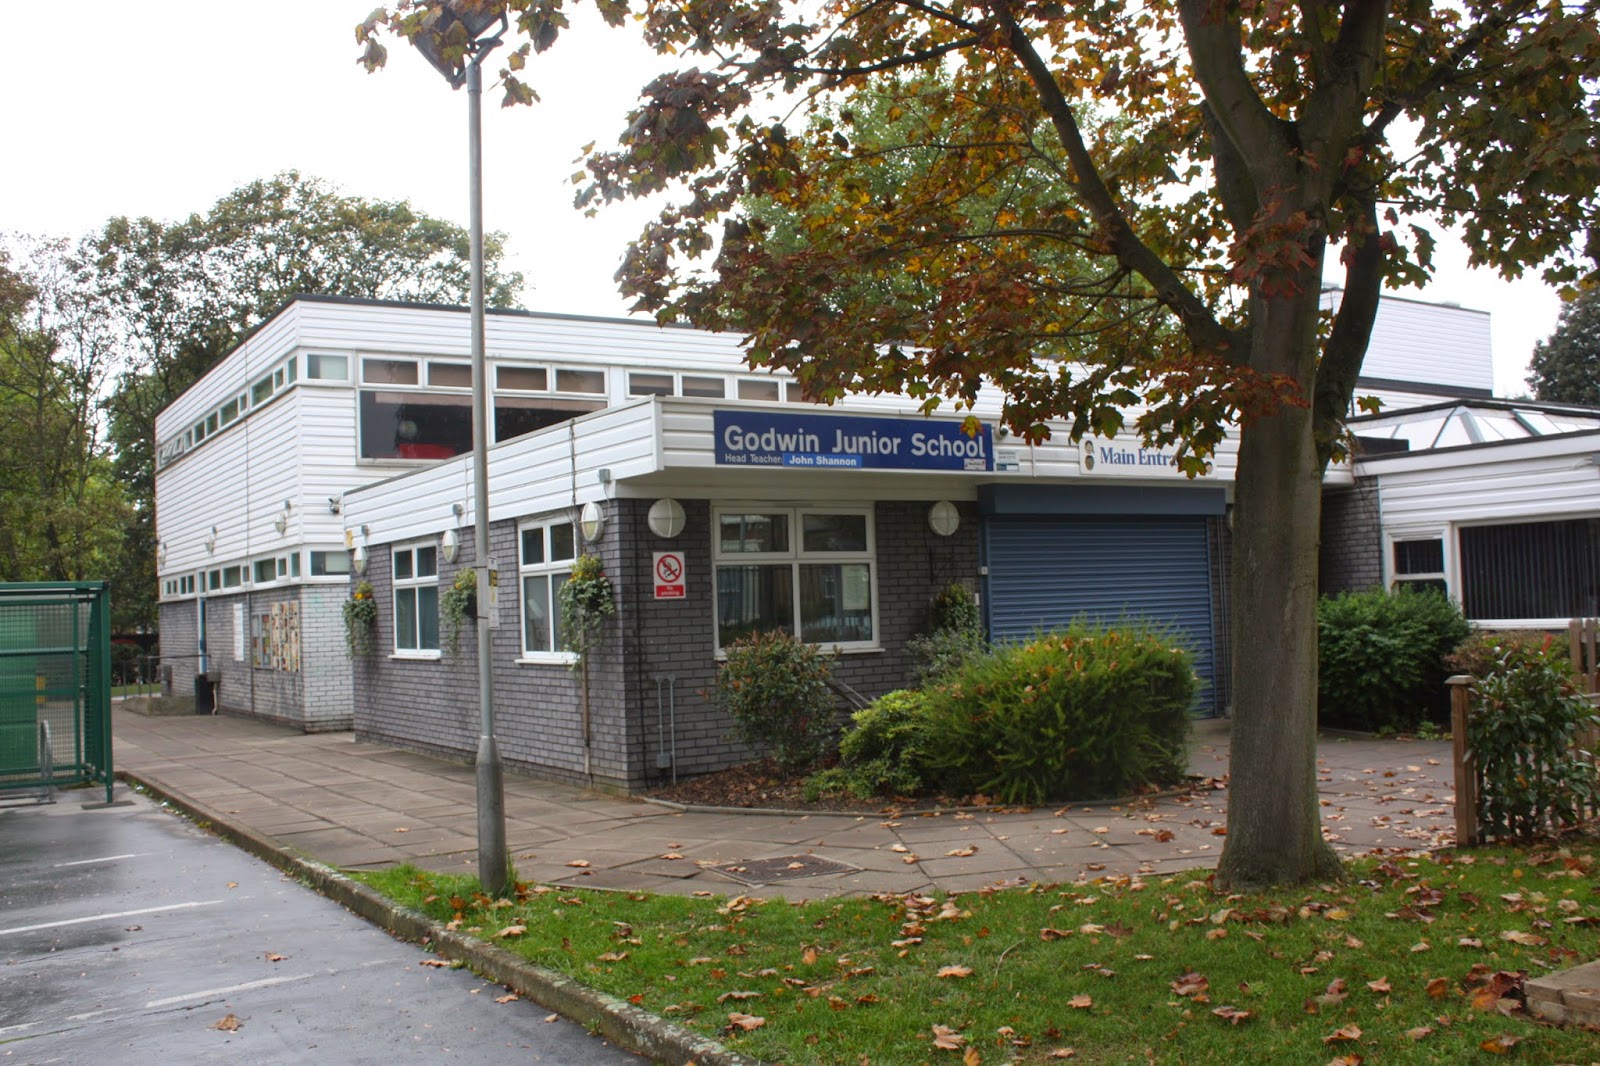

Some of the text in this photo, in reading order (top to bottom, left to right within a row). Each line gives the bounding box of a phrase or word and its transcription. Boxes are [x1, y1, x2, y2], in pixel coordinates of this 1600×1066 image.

[724, 425, 986, 458] Godwin Junior School
[725, 453, 746, 463] Head
[789, 455, 857, 466] John Shannon
[1100, 447, 1135, 465] Main
